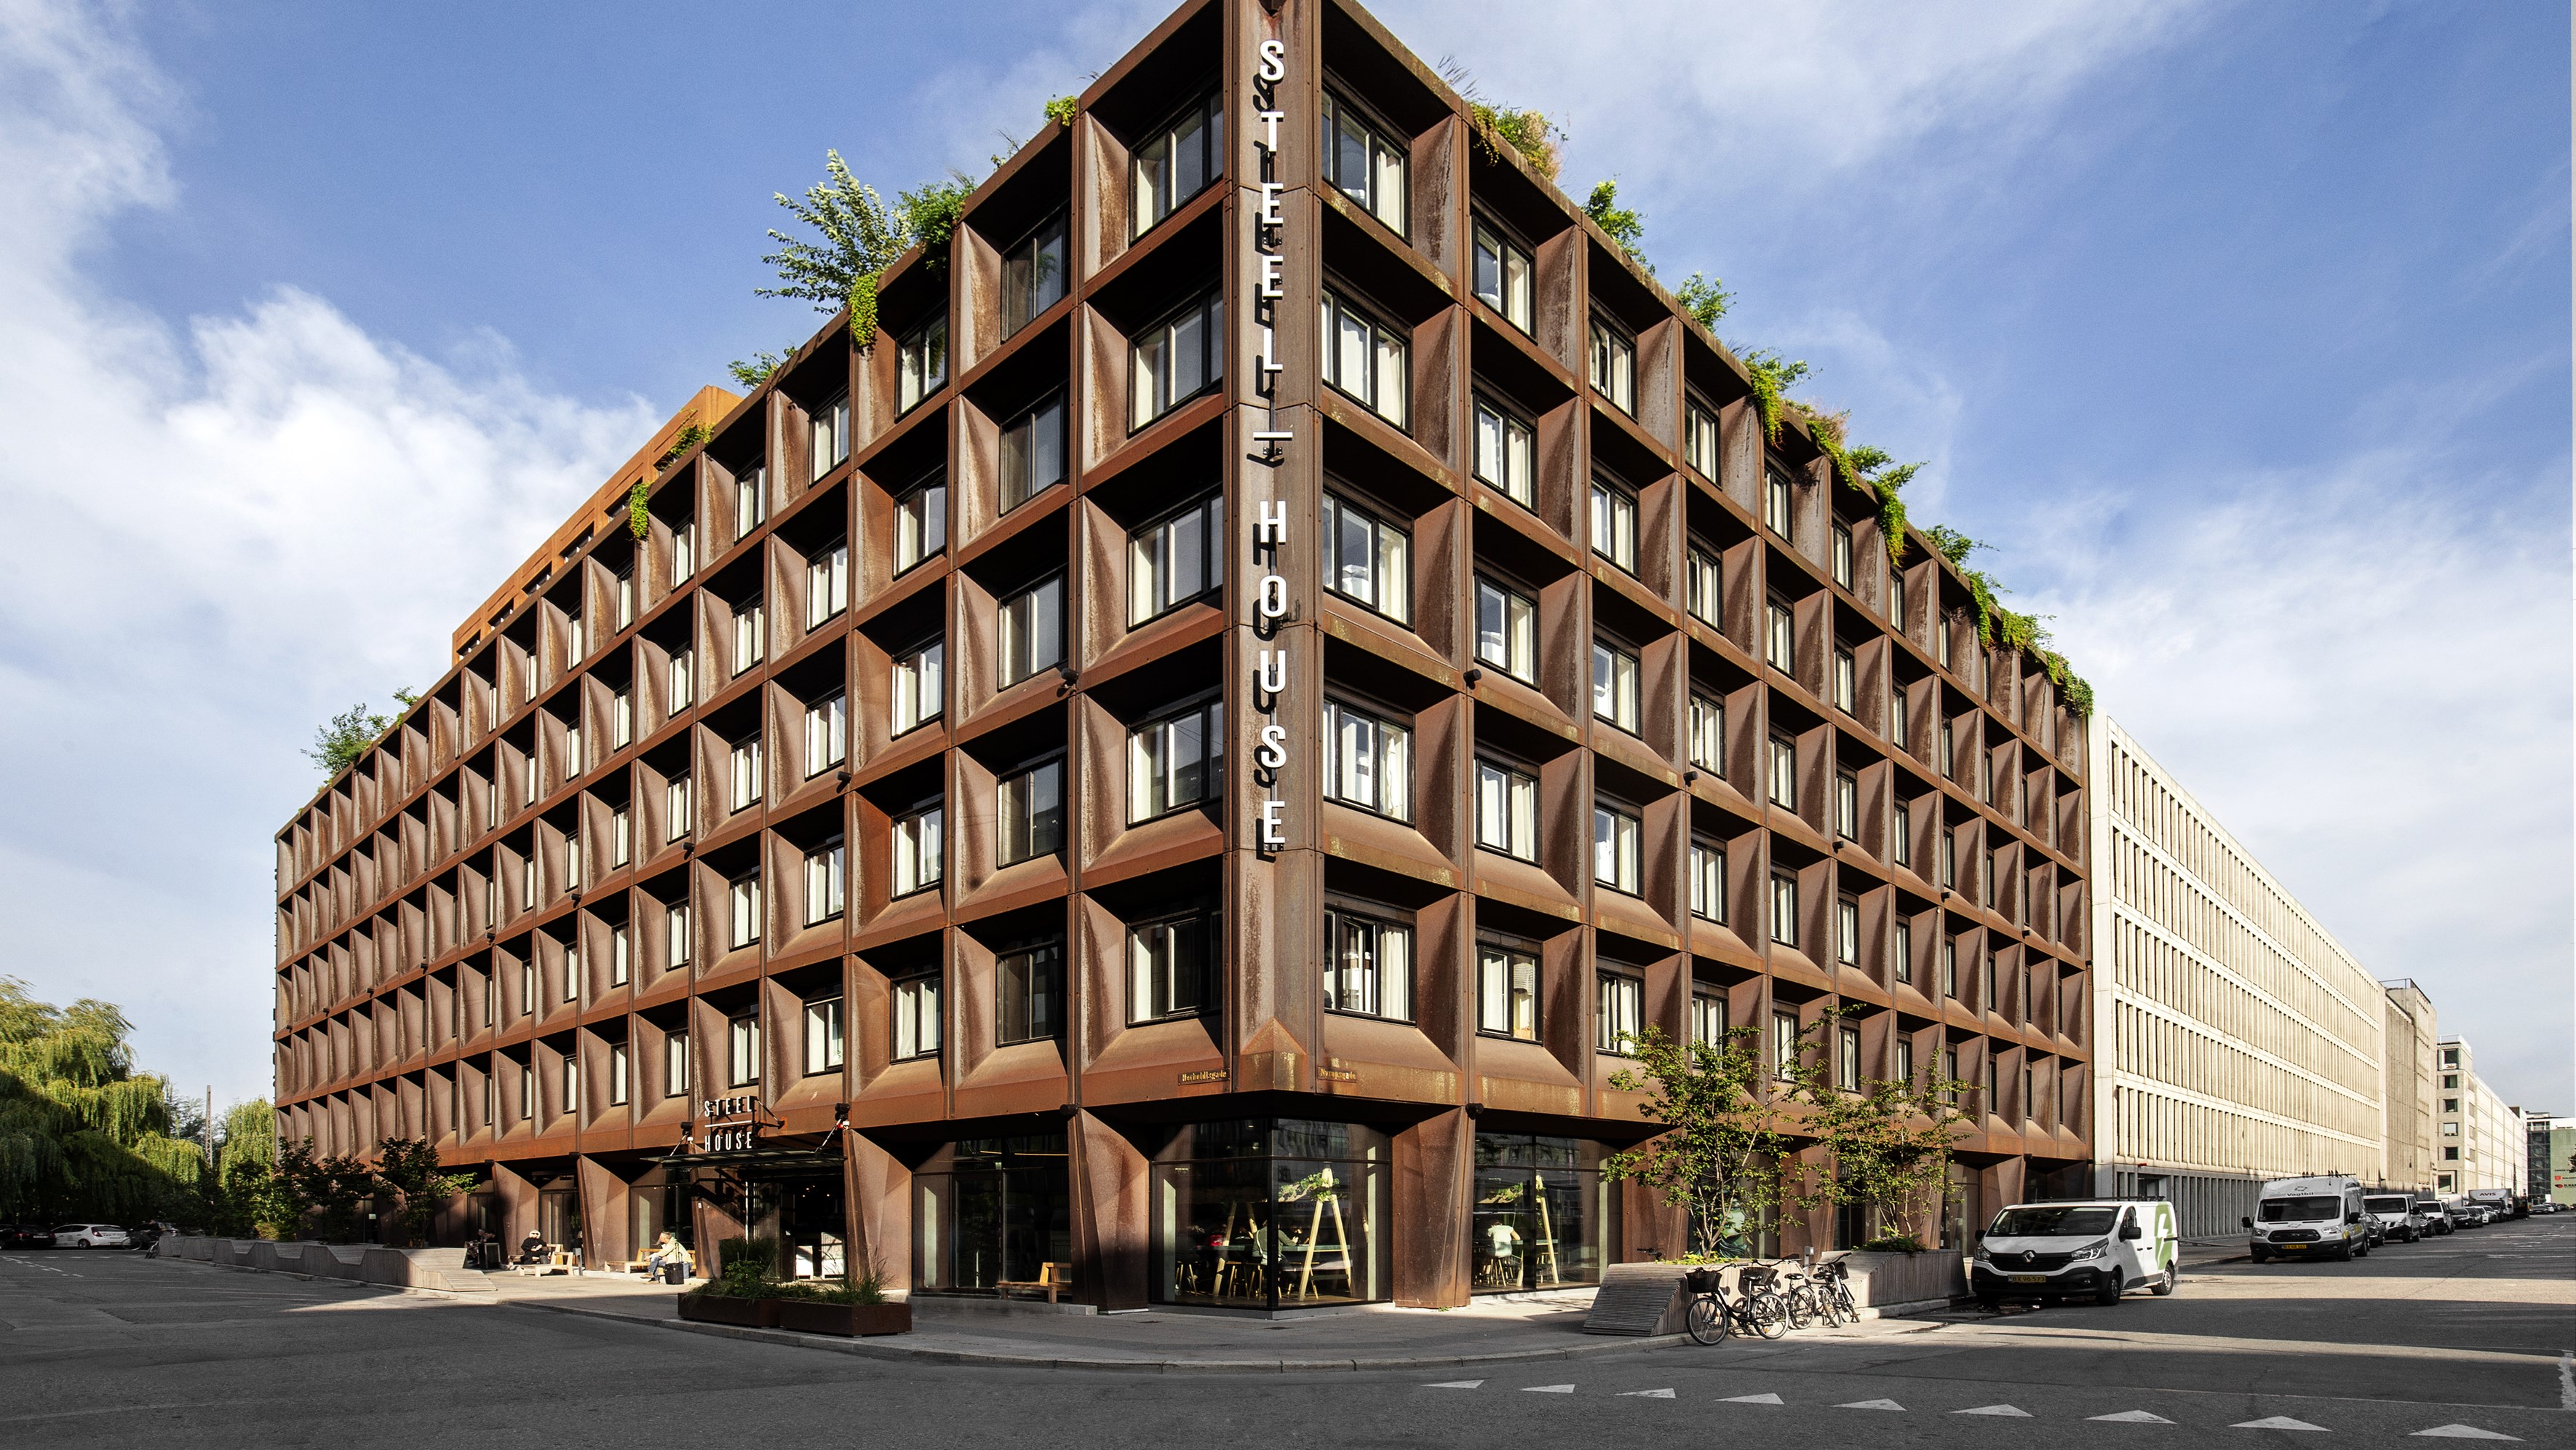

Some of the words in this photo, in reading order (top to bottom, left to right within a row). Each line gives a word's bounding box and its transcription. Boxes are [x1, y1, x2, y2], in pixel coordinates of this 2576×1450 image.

[1260, 39, 1285, 372] STEEL
[1260, 500, 1287, 844] HOUSE
[704, 1096, 752, 1117] STEEL
[704, 1131, 752, 1152] HOUSE
